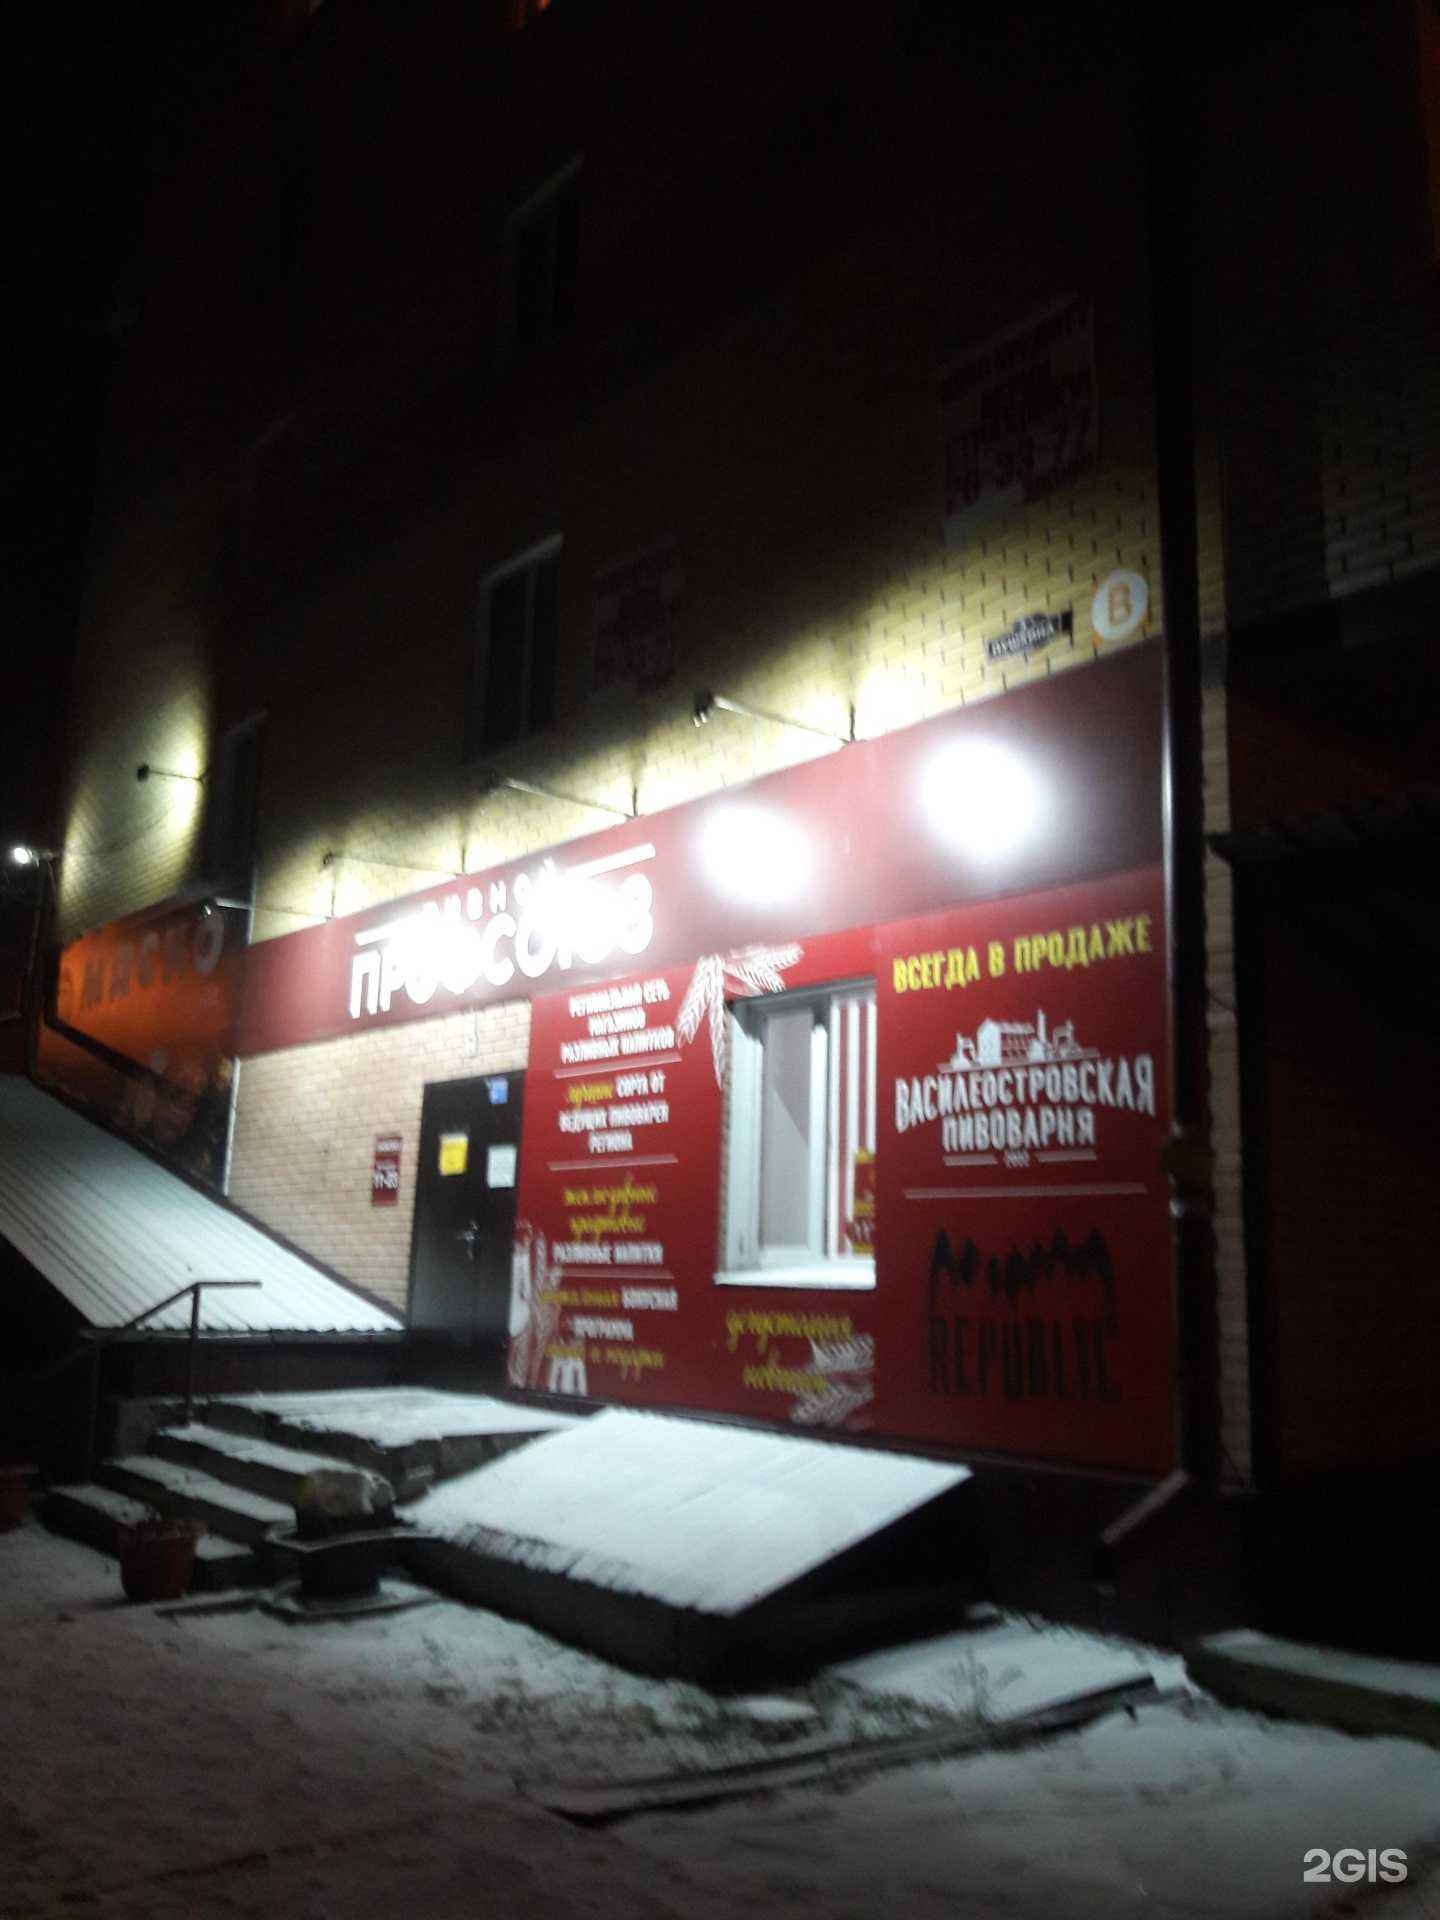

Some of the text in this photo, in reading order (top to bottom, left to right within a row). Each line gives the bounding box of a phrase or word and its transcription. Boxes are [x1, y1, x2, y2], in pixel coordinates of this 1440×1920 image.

[893, 913, 1153, 994] ВСЕГДА В ПРОДАЖЕ
[894, 1052, 1156, 1134] ВАСИЛЕОСТРОВСКАЯ
[941, 1104, 1096, 1153] ПИВОВАРНЯ
